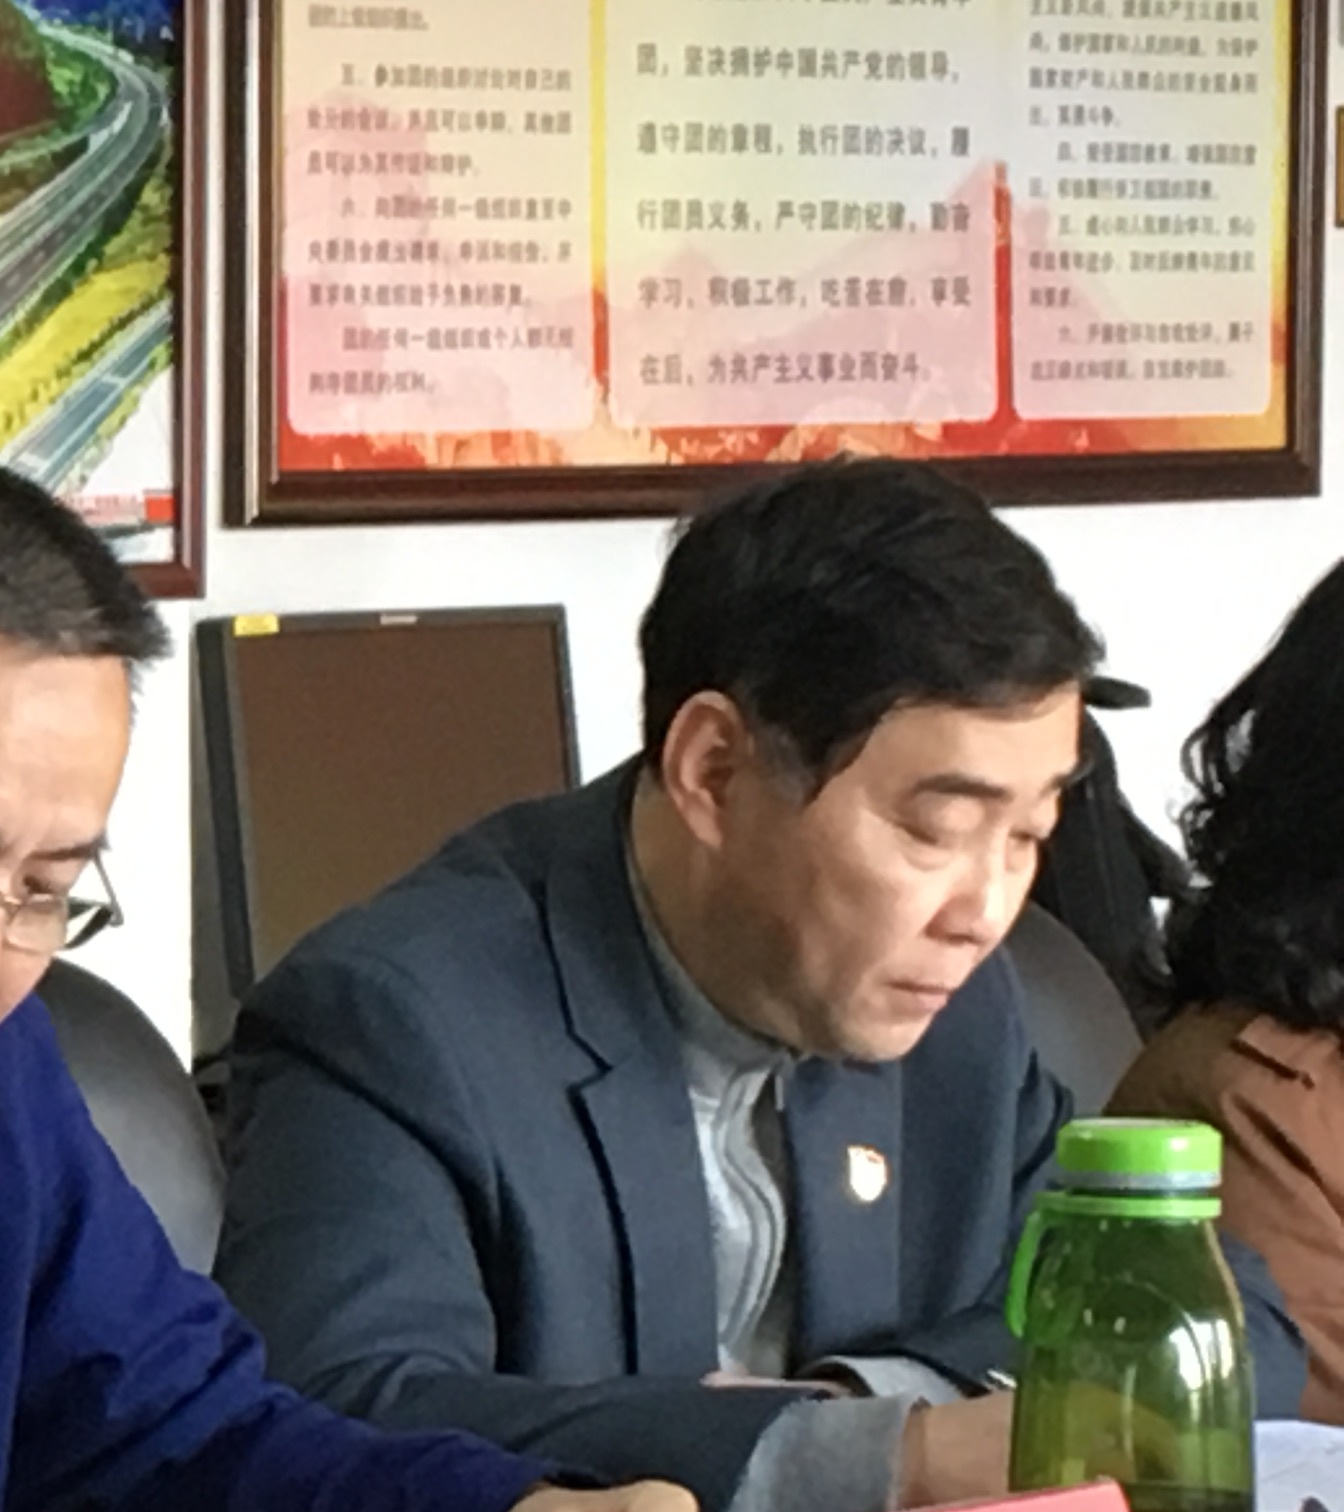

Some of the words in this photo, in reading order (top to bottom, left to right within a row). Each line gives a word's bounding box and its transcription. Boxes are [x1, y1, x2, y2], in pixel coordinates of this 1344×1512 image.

[638, 121, 970, 157] 遵守团的章程，执行团的决议，履
[637, 199, 971, 232] 行团员义务，严守团的纪律，勤奋
[638, 276, 972, 308] 学习，积极工作，吃苦在前，享受
[640, 351, 932, 386] 在后，为共产主义事业而奋斗。
